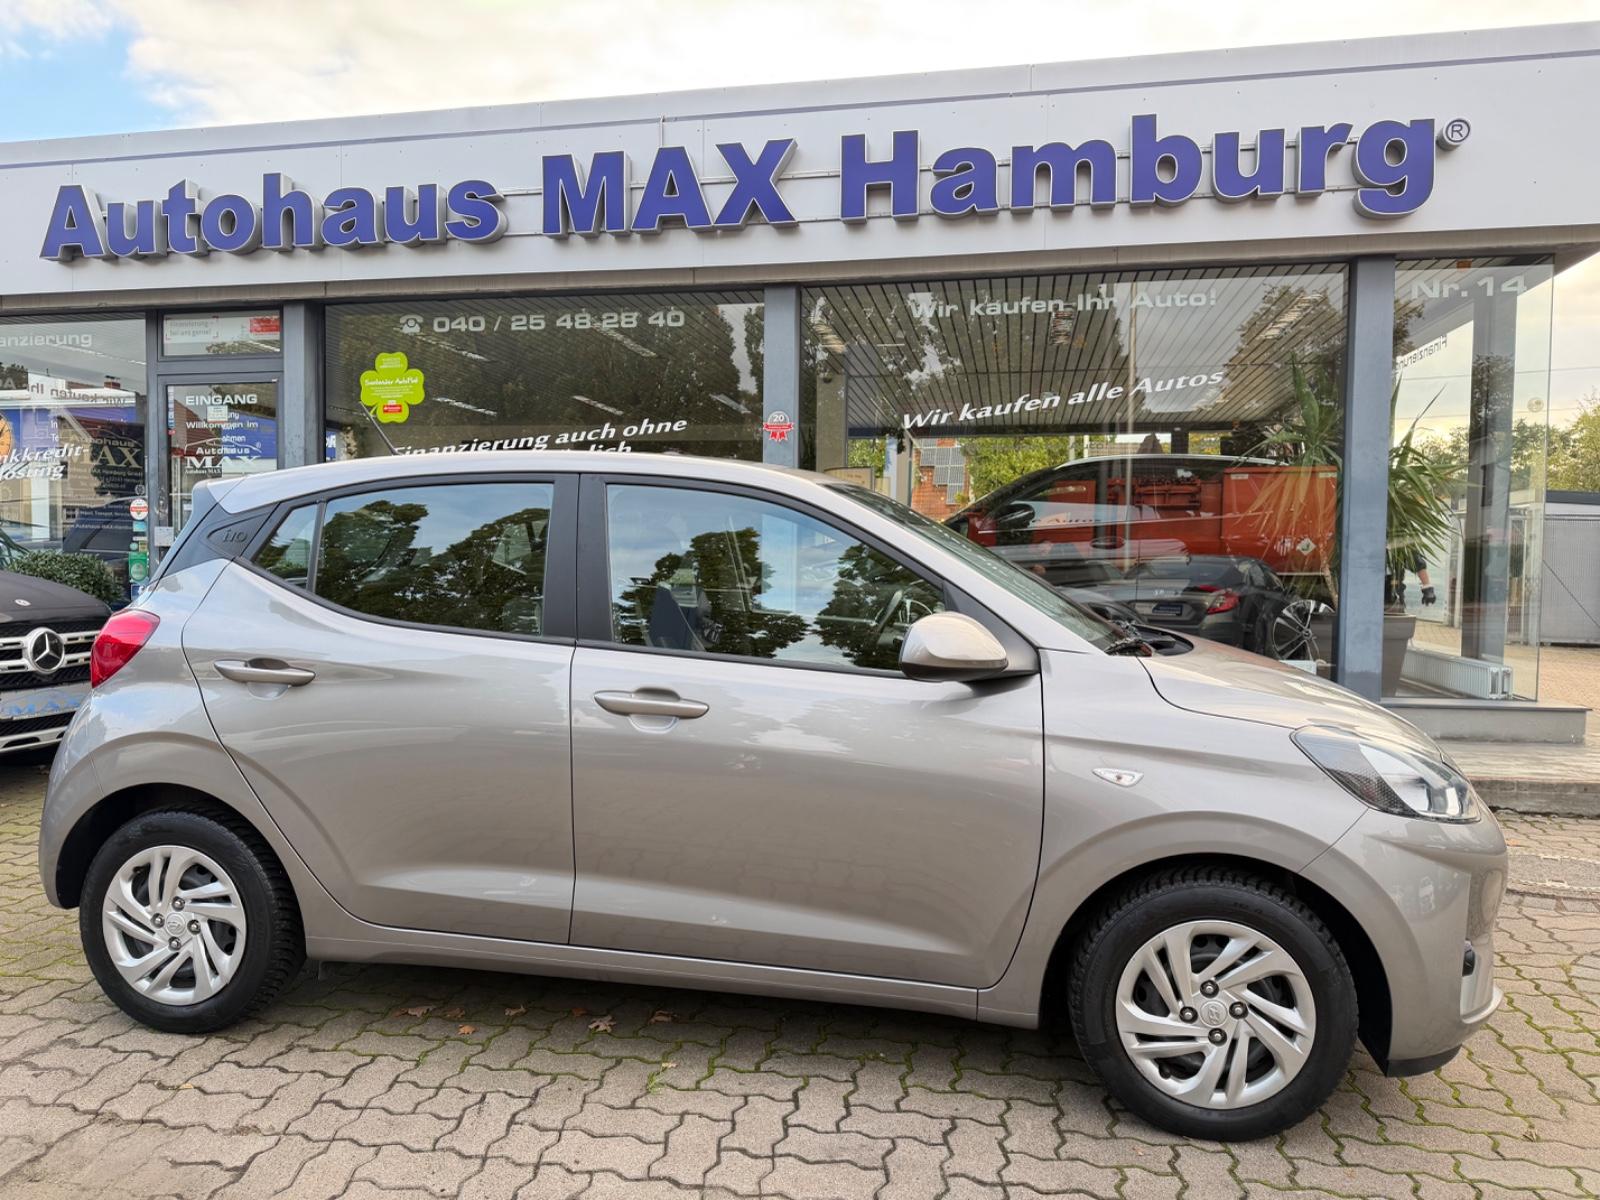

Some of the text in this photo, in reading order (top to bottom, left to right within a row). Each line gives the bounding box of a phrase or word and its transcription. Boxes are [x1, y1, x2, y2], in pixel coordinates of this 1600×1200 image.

[40, 173, 503, 258] Autohaus
[541, 138, 796, 234] MAX
[841, 113, 1436, 220] Hamburg
[1411, 274, 1527, 299] Nr. 14
[909, 288, 1217, 318] Wir kaufen Ihr Auto!
[432, 316, 486, 333] 040
[510, 315, 546, 331] 25
[556, 312, 593, 329] 48
[601, 312, 638, 328] 28
[648, 310, 685, 327] 40
[185, 394, 258, 406] EINGANG
[901, 371, 1225, 429] Wir kaufen alle Autos
[186, 421, 243, 430] Willkommen
[555, 422, 616, 444] auch
[622, 417, 688, 437] ohne
[772, 414, 785, 422] 20
